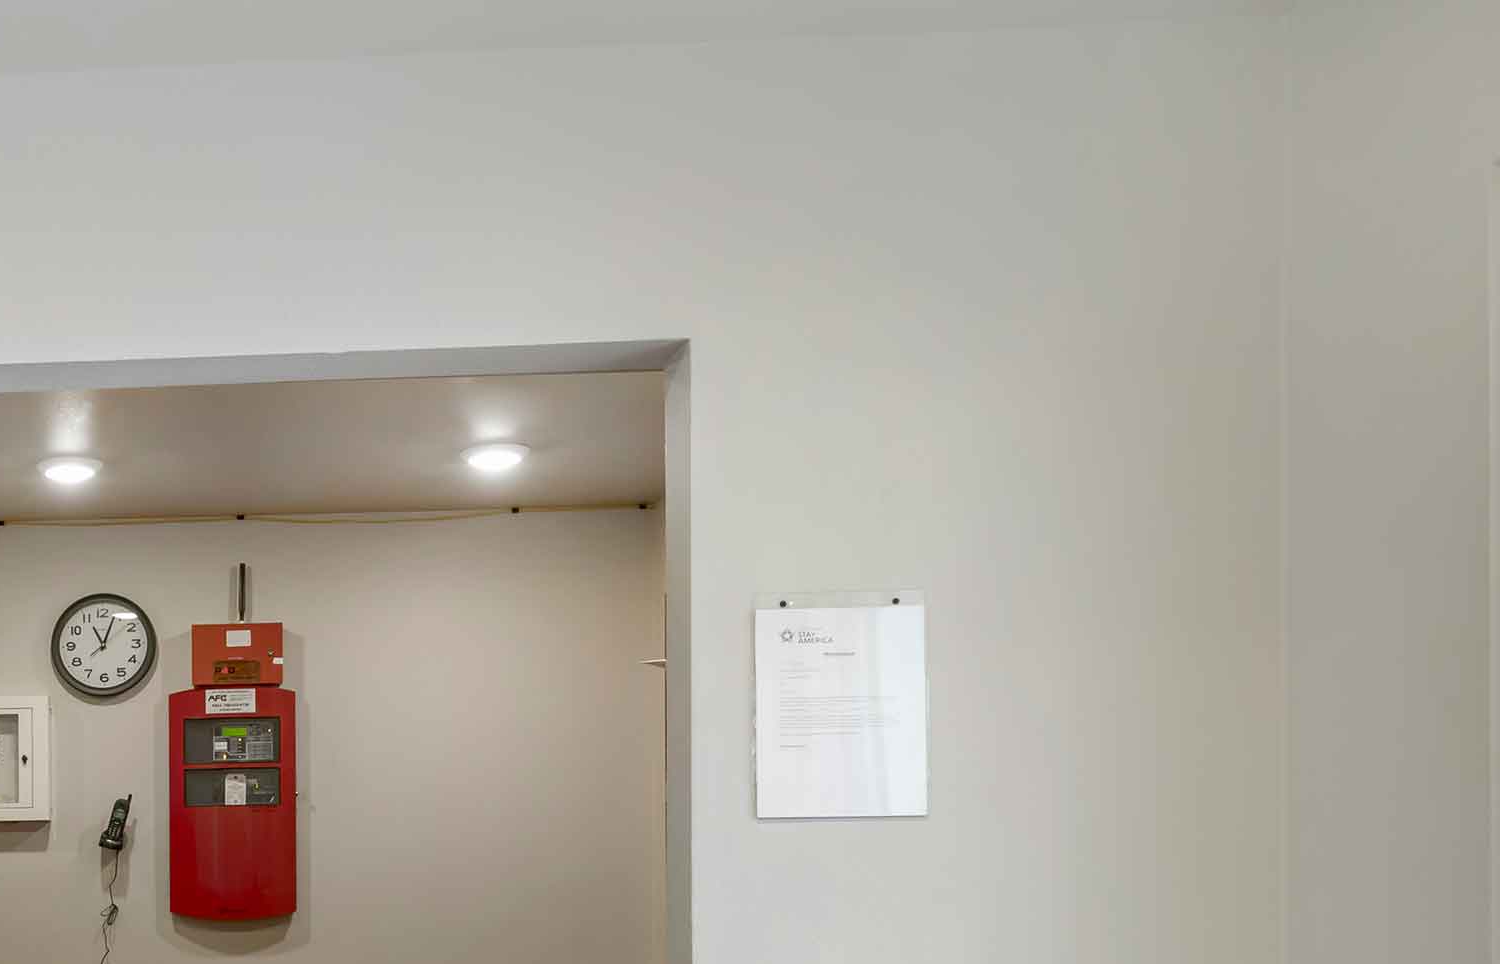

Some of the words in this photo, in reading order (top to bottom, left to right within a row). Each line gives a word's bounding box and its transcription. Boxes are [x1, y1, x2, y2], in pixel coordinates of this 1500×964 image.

[82, 613, 91, 623] 11
[96, 608, 109, 618] 12
[70, 625, 82, 636] 10
[126, 623, 137, 632] 2
[66, 641, 76, 651] 9
[131, 639, 141, 649] 3
[71, 657, 82, 667] 8
[128, 654, 137, 664] 4
[84, 669, 93, 679] 7
[116, 667, 127, 677] 5
[99, 673, 109, 683] 6
